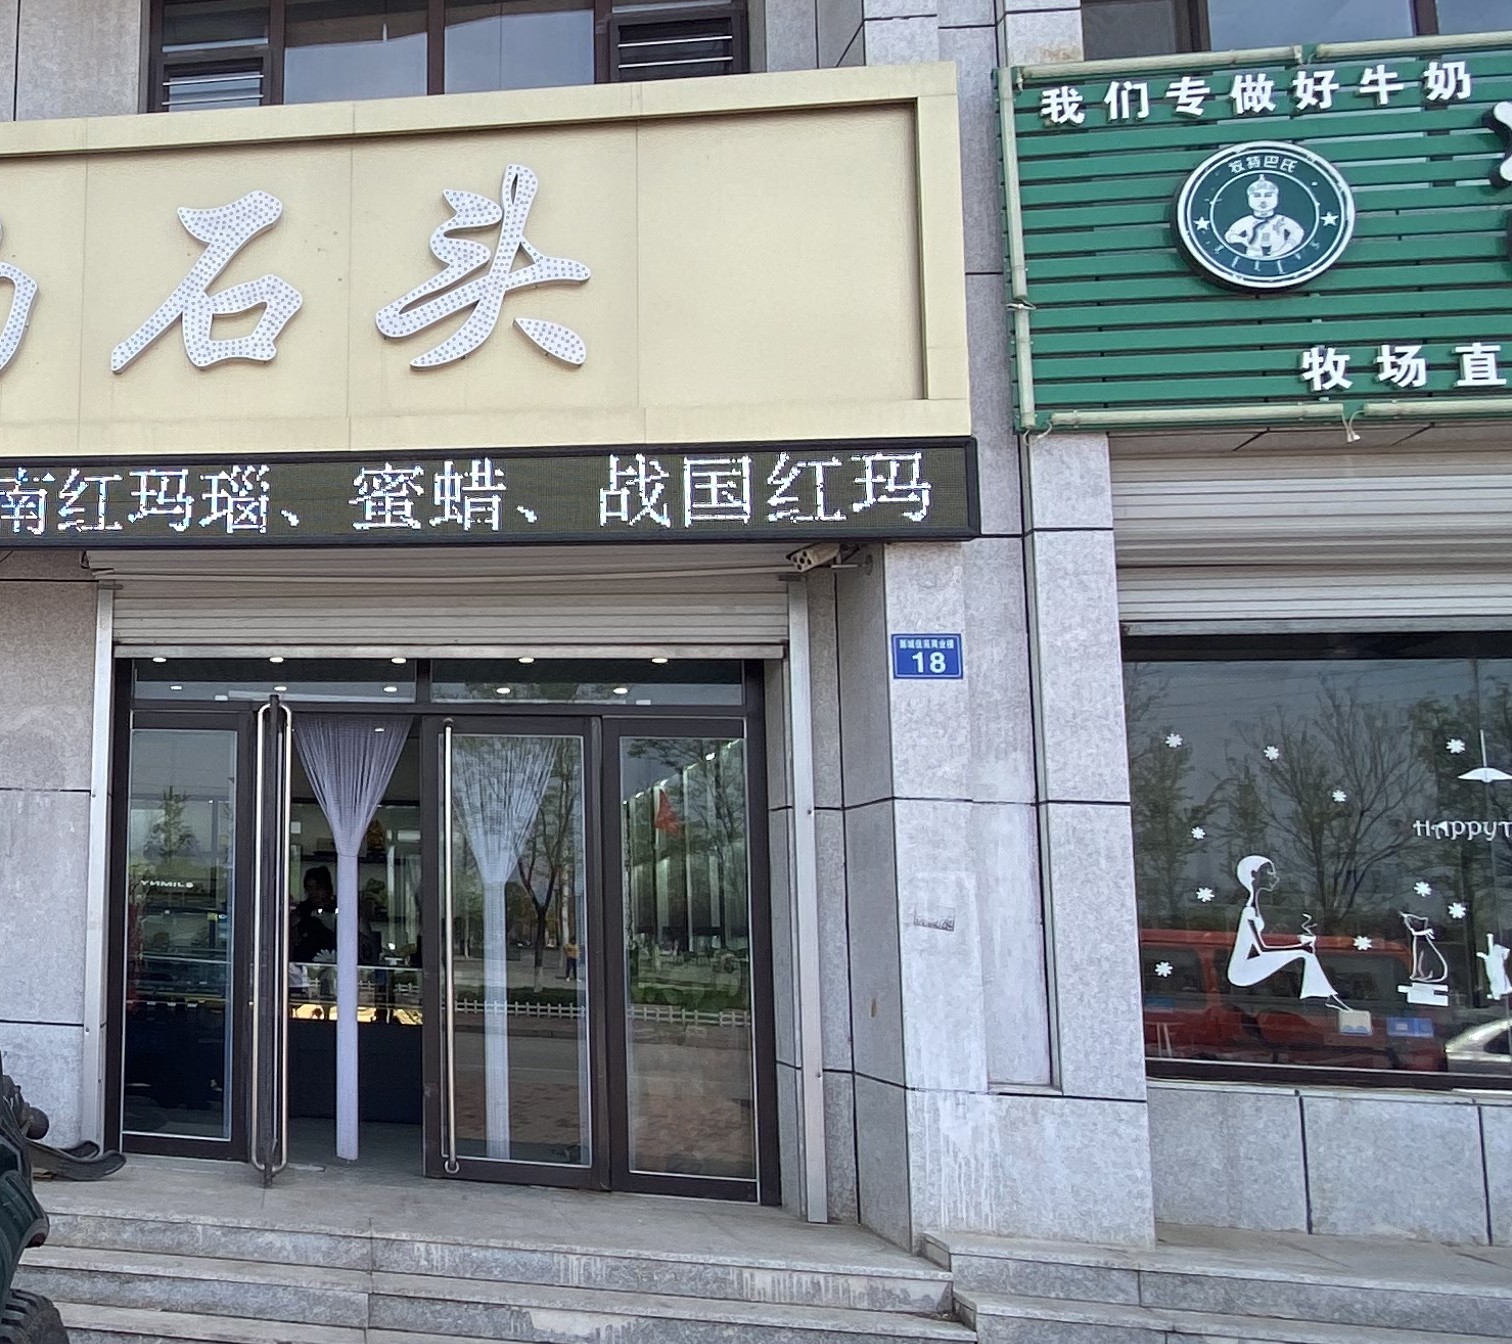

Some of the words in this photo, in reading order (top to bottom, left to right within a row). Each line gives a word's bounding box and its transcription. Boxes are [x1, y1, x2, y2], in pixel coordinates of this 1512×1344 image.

[1040, 60, 1473, 126] 我们专做好牛奶
[1300, 342, 1507, 392] 牧场直
[912, 651, 946, 673] 18
